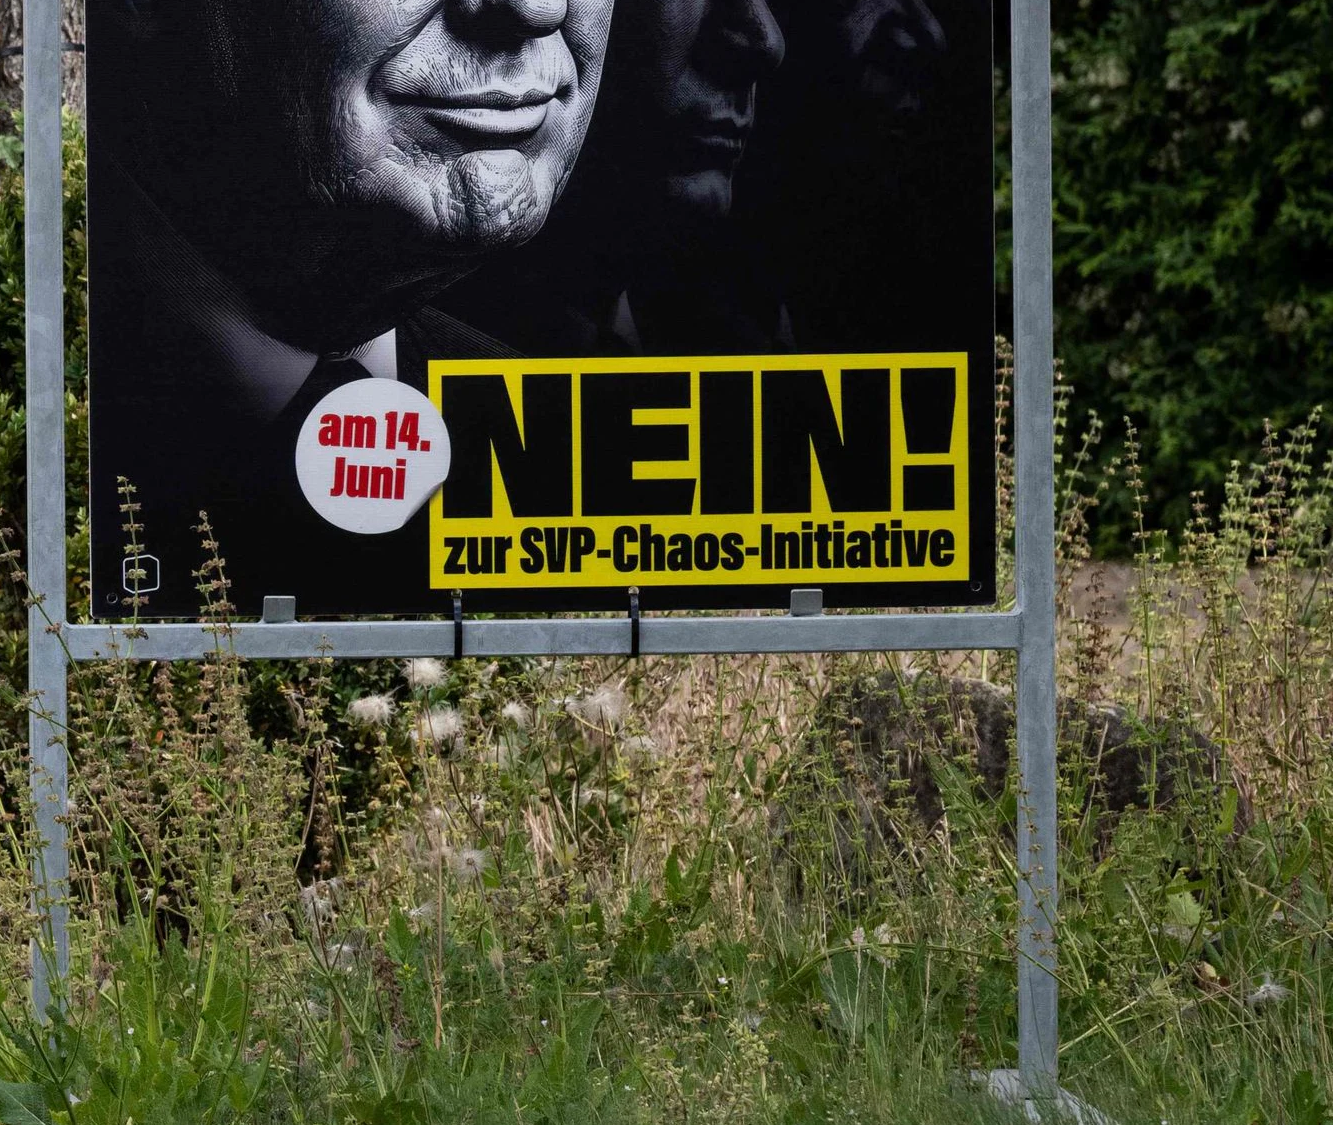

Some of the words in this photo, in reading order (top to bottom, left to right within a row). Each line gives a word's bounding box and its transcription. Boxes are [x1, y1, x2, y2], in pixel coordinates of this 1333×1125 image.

[317, 413, 377, 450] am
[384, 410, 432, 452] 14.
[439, 366, 957, 520] NEIN!
[329, 456, 406, 501] Juni
[443, 535, 513, 575] zur
[519, 519, 956, 574] SVP-Chaos-Initiative
